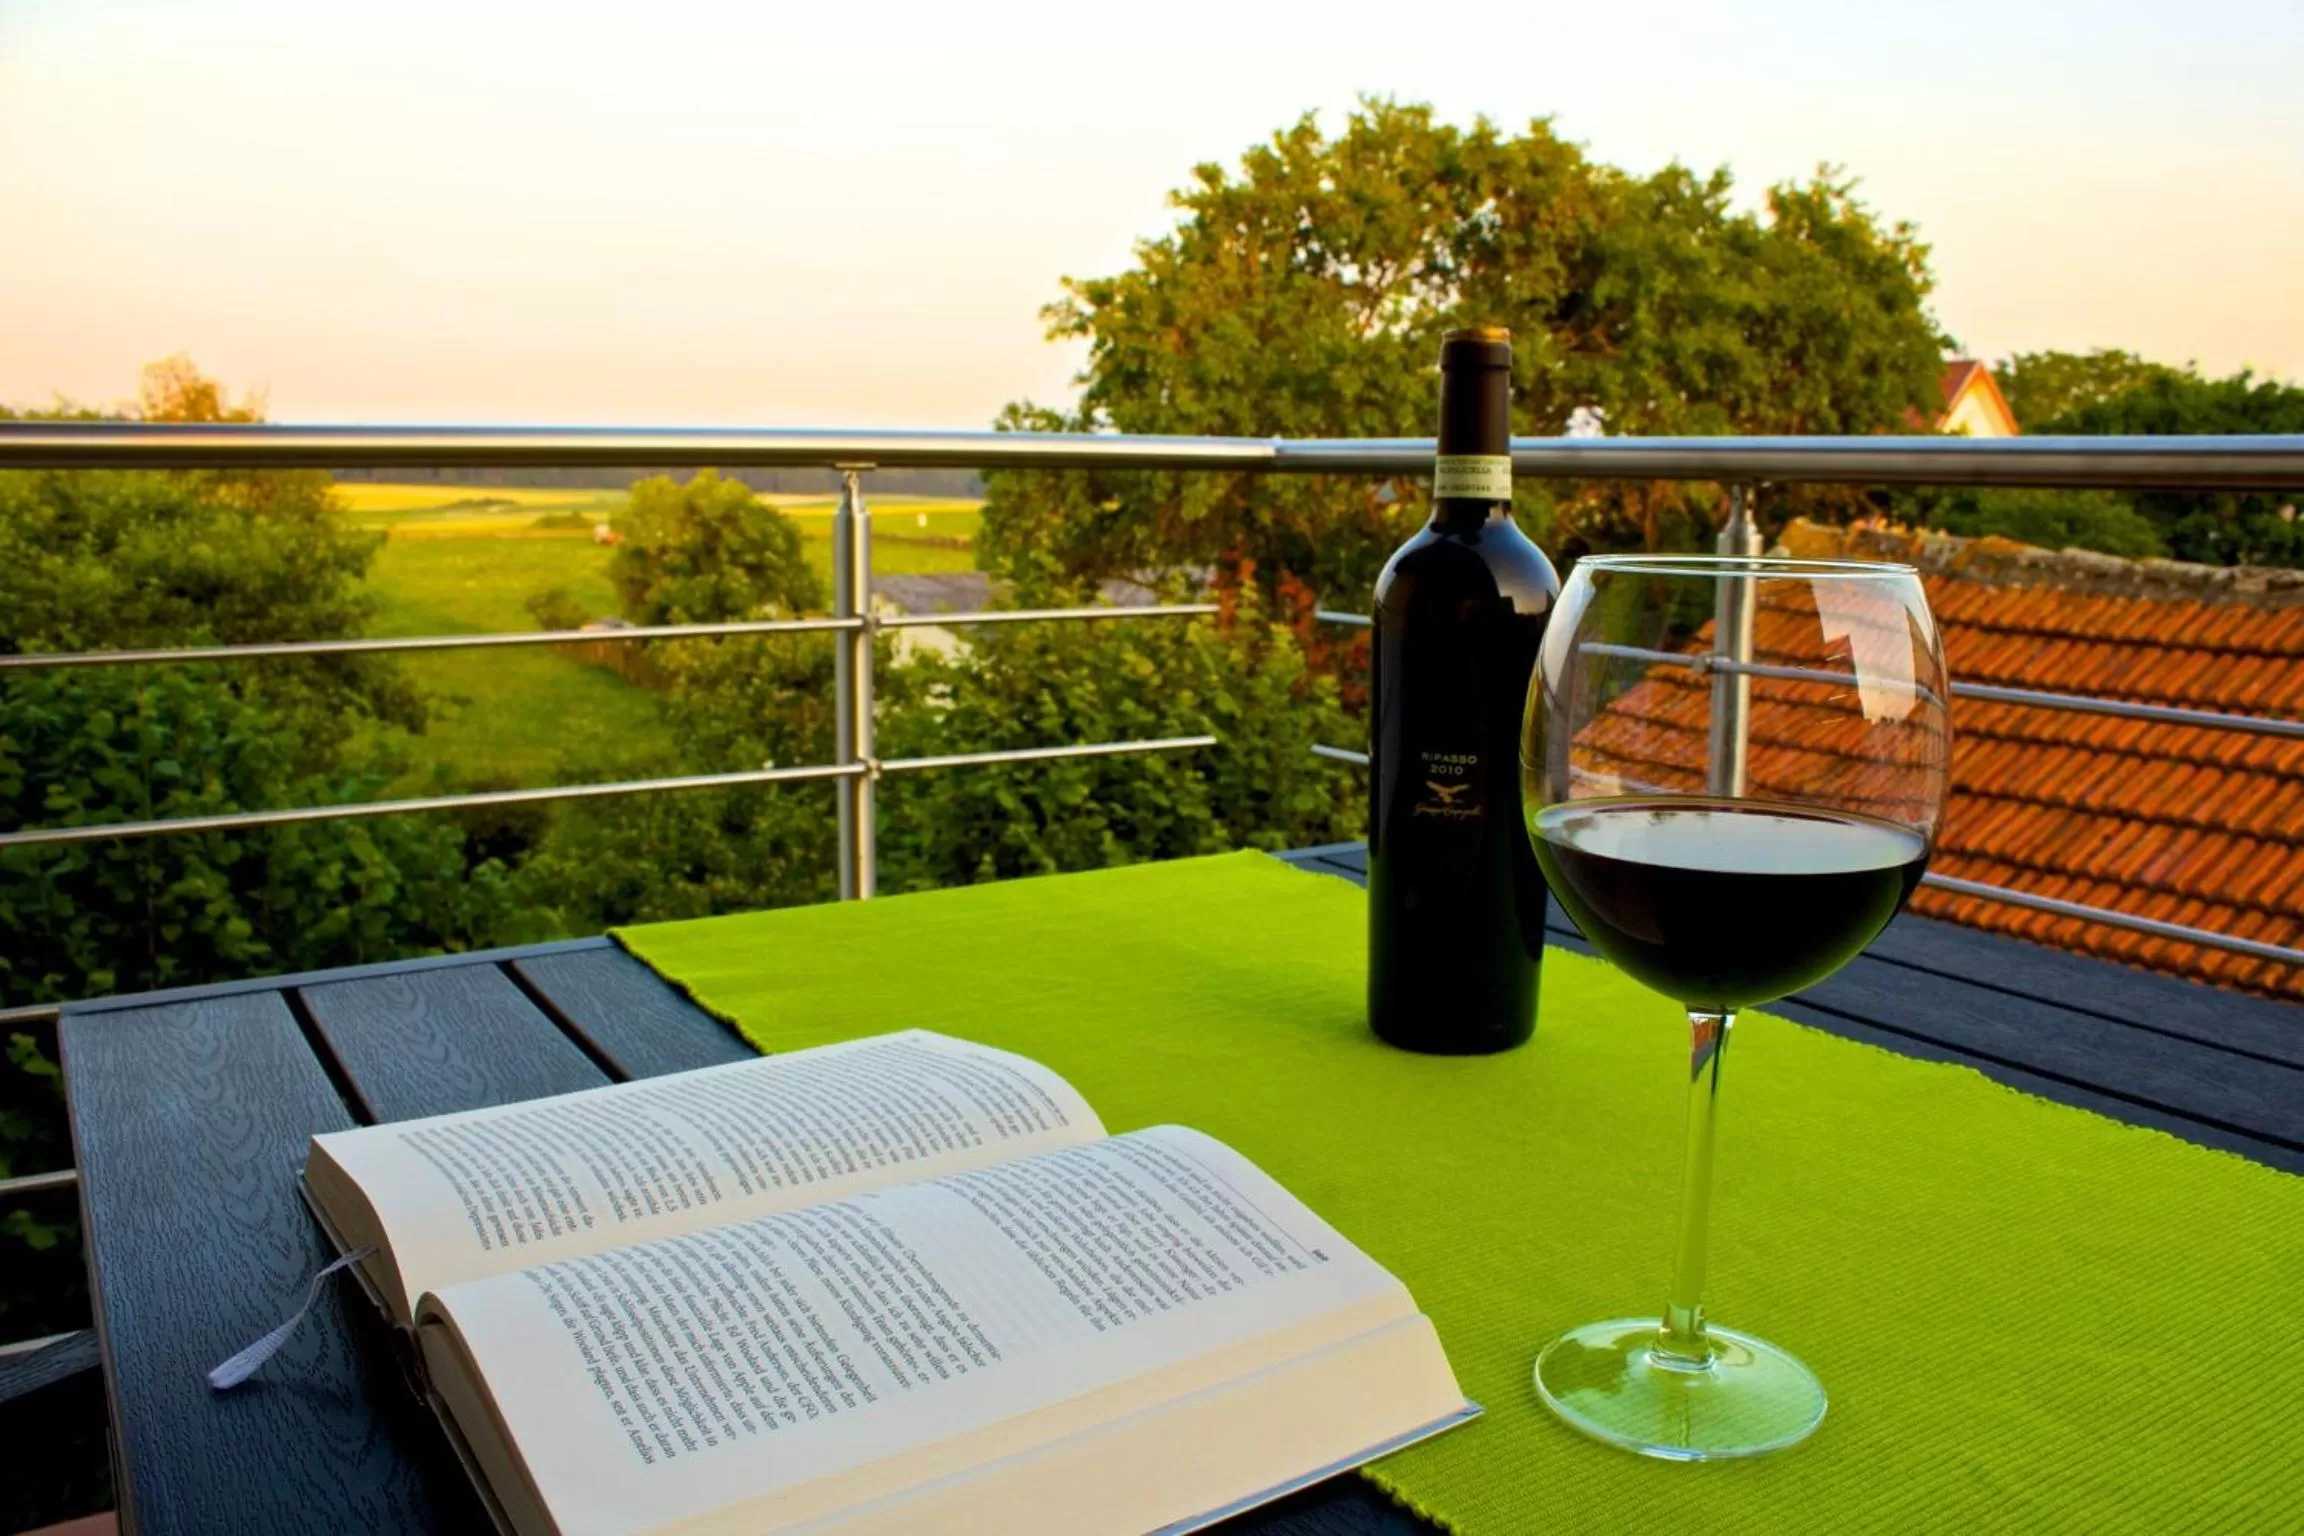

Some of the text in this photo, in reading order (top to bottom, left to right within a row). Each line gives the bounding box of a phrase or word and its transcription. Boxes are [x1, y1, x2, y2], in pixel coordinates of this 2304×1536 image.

[1421, 752, 1478, 765] RIPASSO
[1430, 764, 1464, 775] 2010
[562, 1315, 580, 1330] die
[570, 1328, 603, 1365] Woolard
[683, 1330, 708, 1353] mich
[614, 1365, 636, 1384] und
[758, 1375, 781, 1394] und
[622, 1340, 644, 1359] und
[642, 1376, 662, 1397] dass
[659, 1405, 686, 1429] nicht
[673, 1427, 700, 1453] mehr
[623, 1381, 643, 1402] dass
[658, 1362, 680, 1387] diese
[671, 1385, 716, 1437] Möglichkeit
[681, 1364, 726, 1423] Unternehmen
[730, 1368, 756, 1396] Apple
[747, 1394, 769, 1411] auf
[608, 1399, 631, 1416] seit
[634, 1401, 658, 1423] auch
[625, 1426, 659, 1465] Amelios
[651, 1430, 679, 1459] daran
